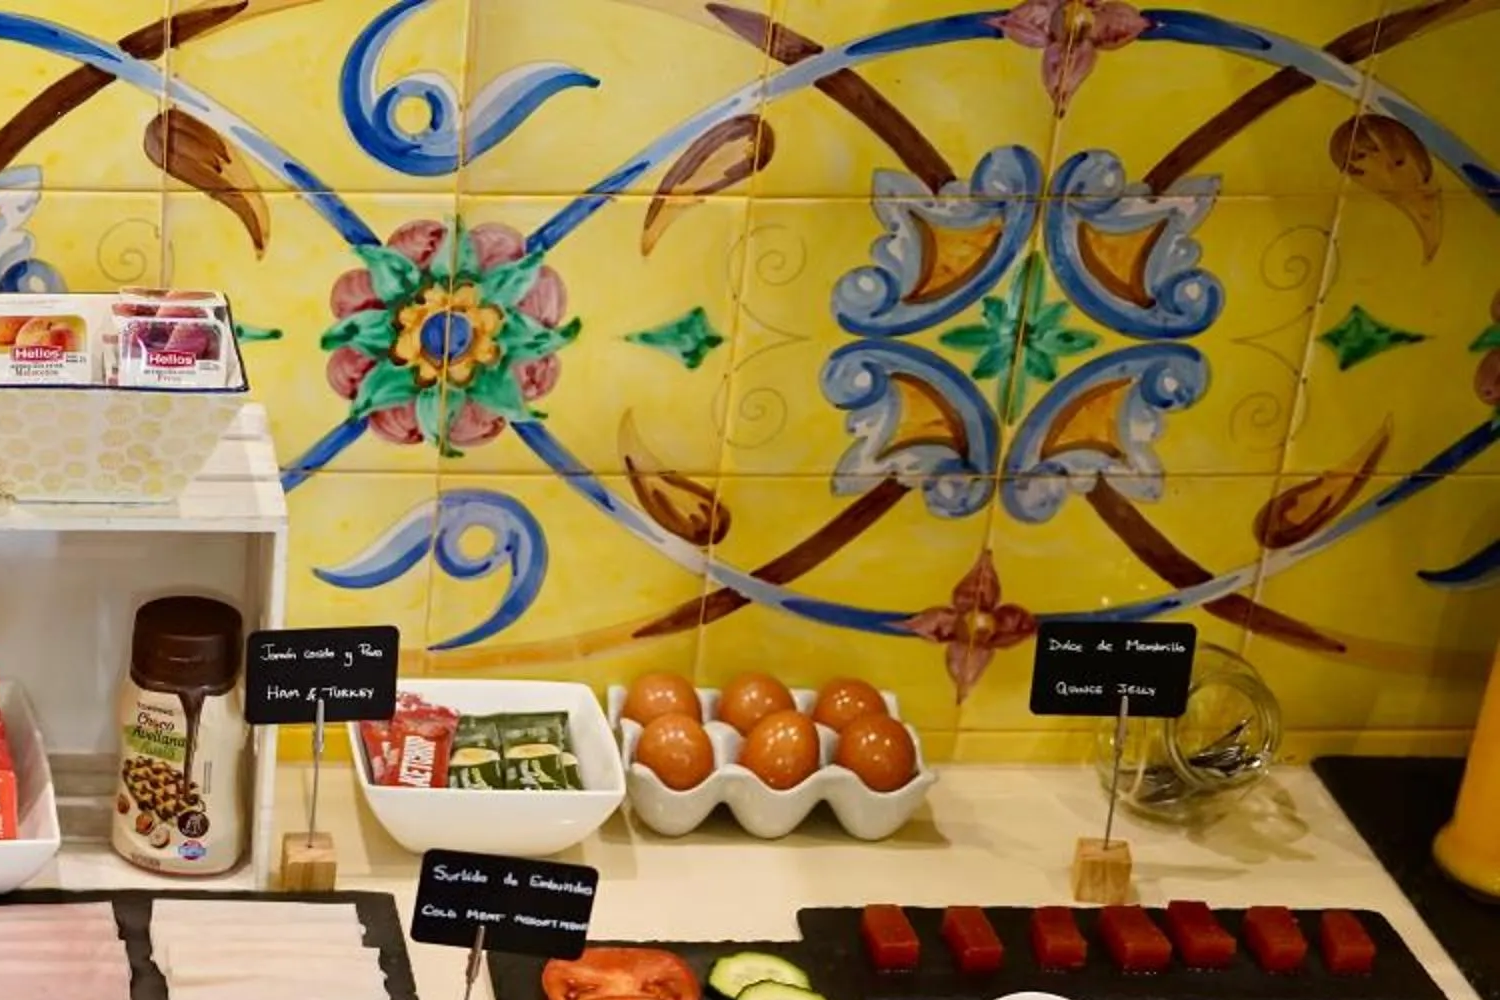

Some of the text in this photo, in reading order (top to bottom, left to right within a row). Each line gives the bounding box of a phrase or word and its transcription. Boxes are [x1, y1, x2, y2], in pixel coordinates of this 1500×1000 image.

[15, 348, 62, 360] Helios
[149, 355, 193, 366] Helios
[1097, 640, 1113, 652] de
[343, 651, 353, 667] y
[503, 872, 519, 886] de
